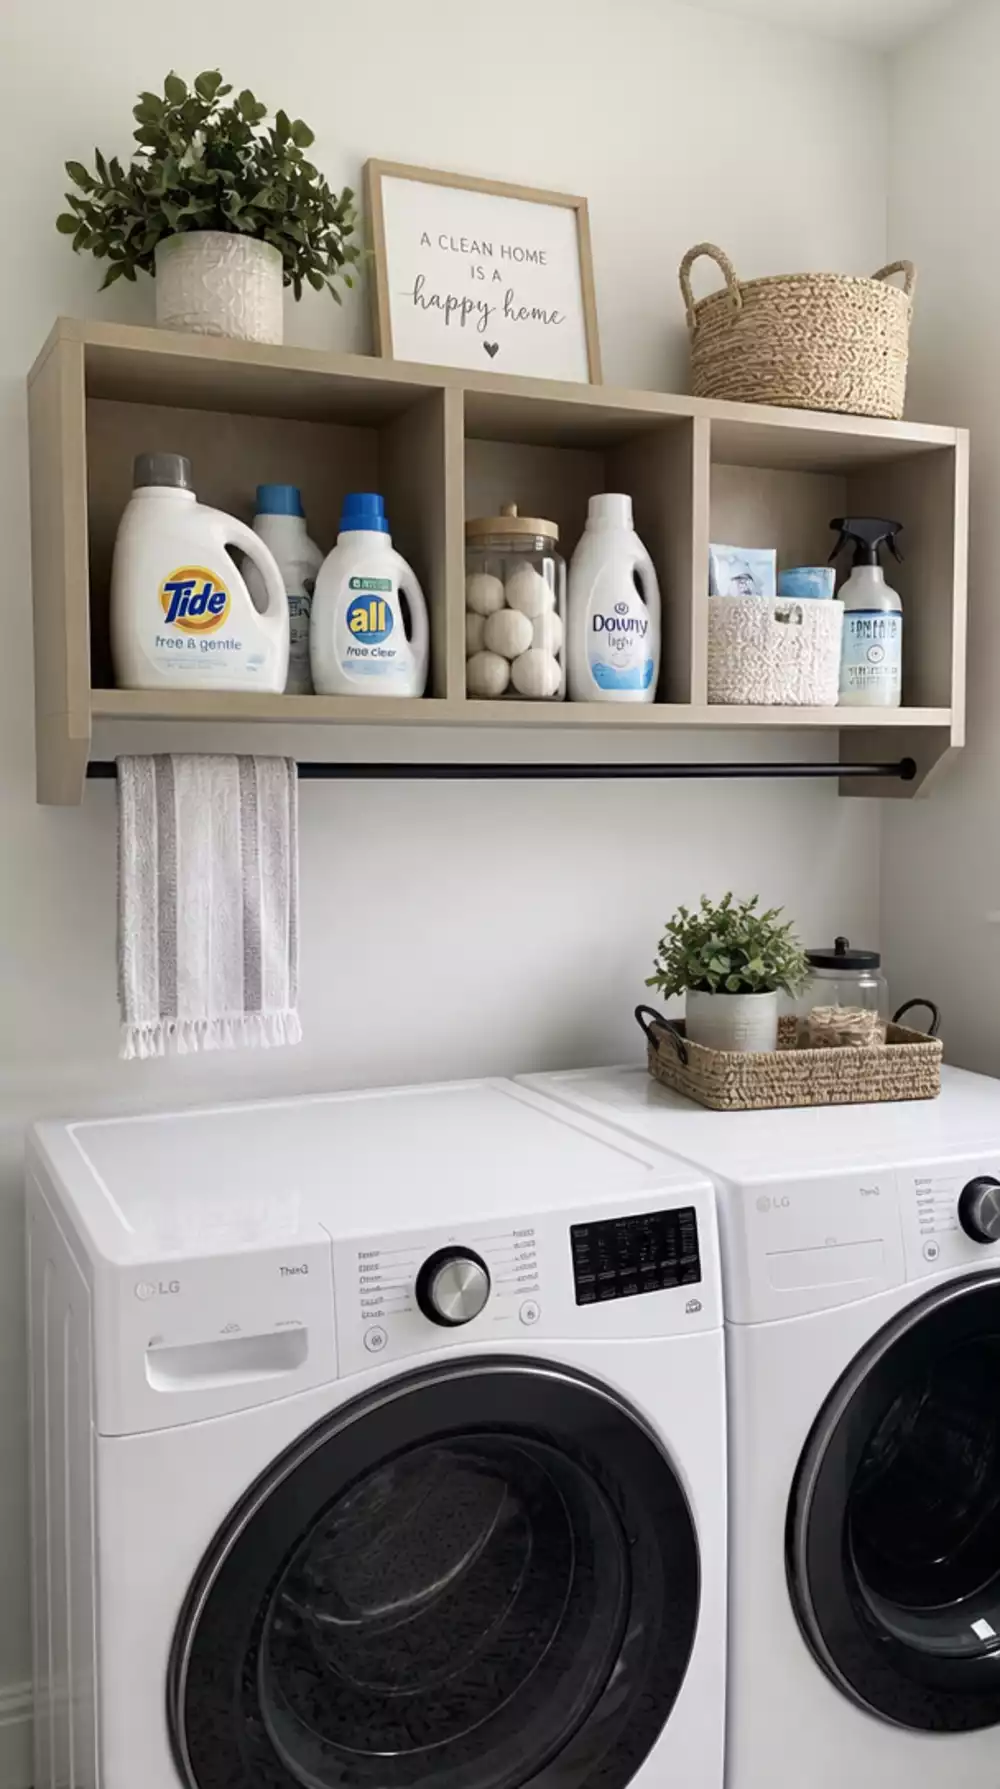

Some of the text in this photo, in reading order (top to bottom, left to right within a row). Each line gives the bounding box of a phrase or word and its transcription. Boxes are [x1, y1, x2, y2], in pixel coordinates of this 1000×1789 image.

[420, 232, 547, 265] A CLEAN HOME
[470, 265, 502, 282] IS A
[398, 274, 496, 333] happy
[163, 580, 226, 624] Tide
[350, 600, 386, 632] all
[593, 614, 648, 638] Downy
[155, 636, 184, 649] free
[773, 1196, 790, 1209] LG
[158, 1281, 181, 1295] LG
